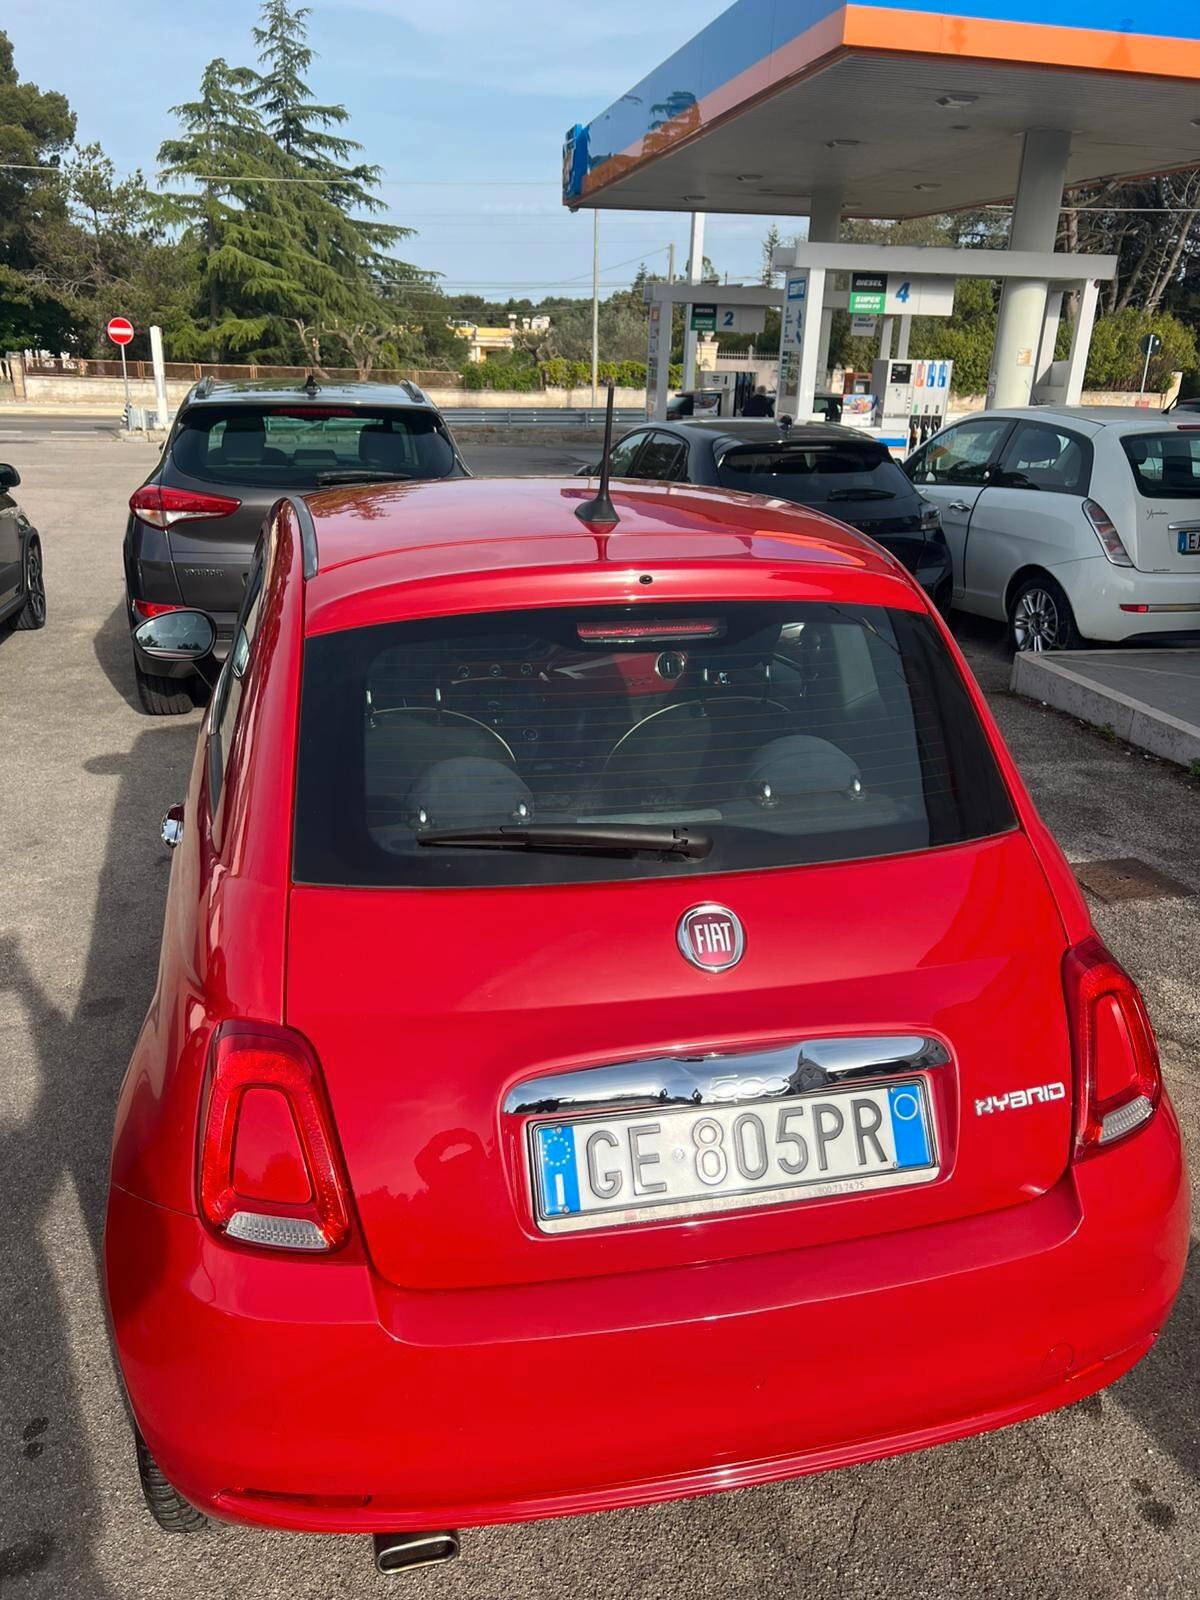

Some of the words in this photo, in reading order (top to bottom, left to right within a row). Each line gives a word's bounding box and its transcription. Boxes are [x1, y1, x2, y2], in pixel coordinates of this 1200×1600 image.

[895, 281, 911, 303] 4
[723, 311, 735, 326] 2
[693, 921, 732, 954] FIAT
[705, 1073, 792, 1102] 500
[974, 1081, 1066, 1117] HYBRID
[585, 1123, 668, 1200] GE
[691, 1097, 889, 1187] 805PR
